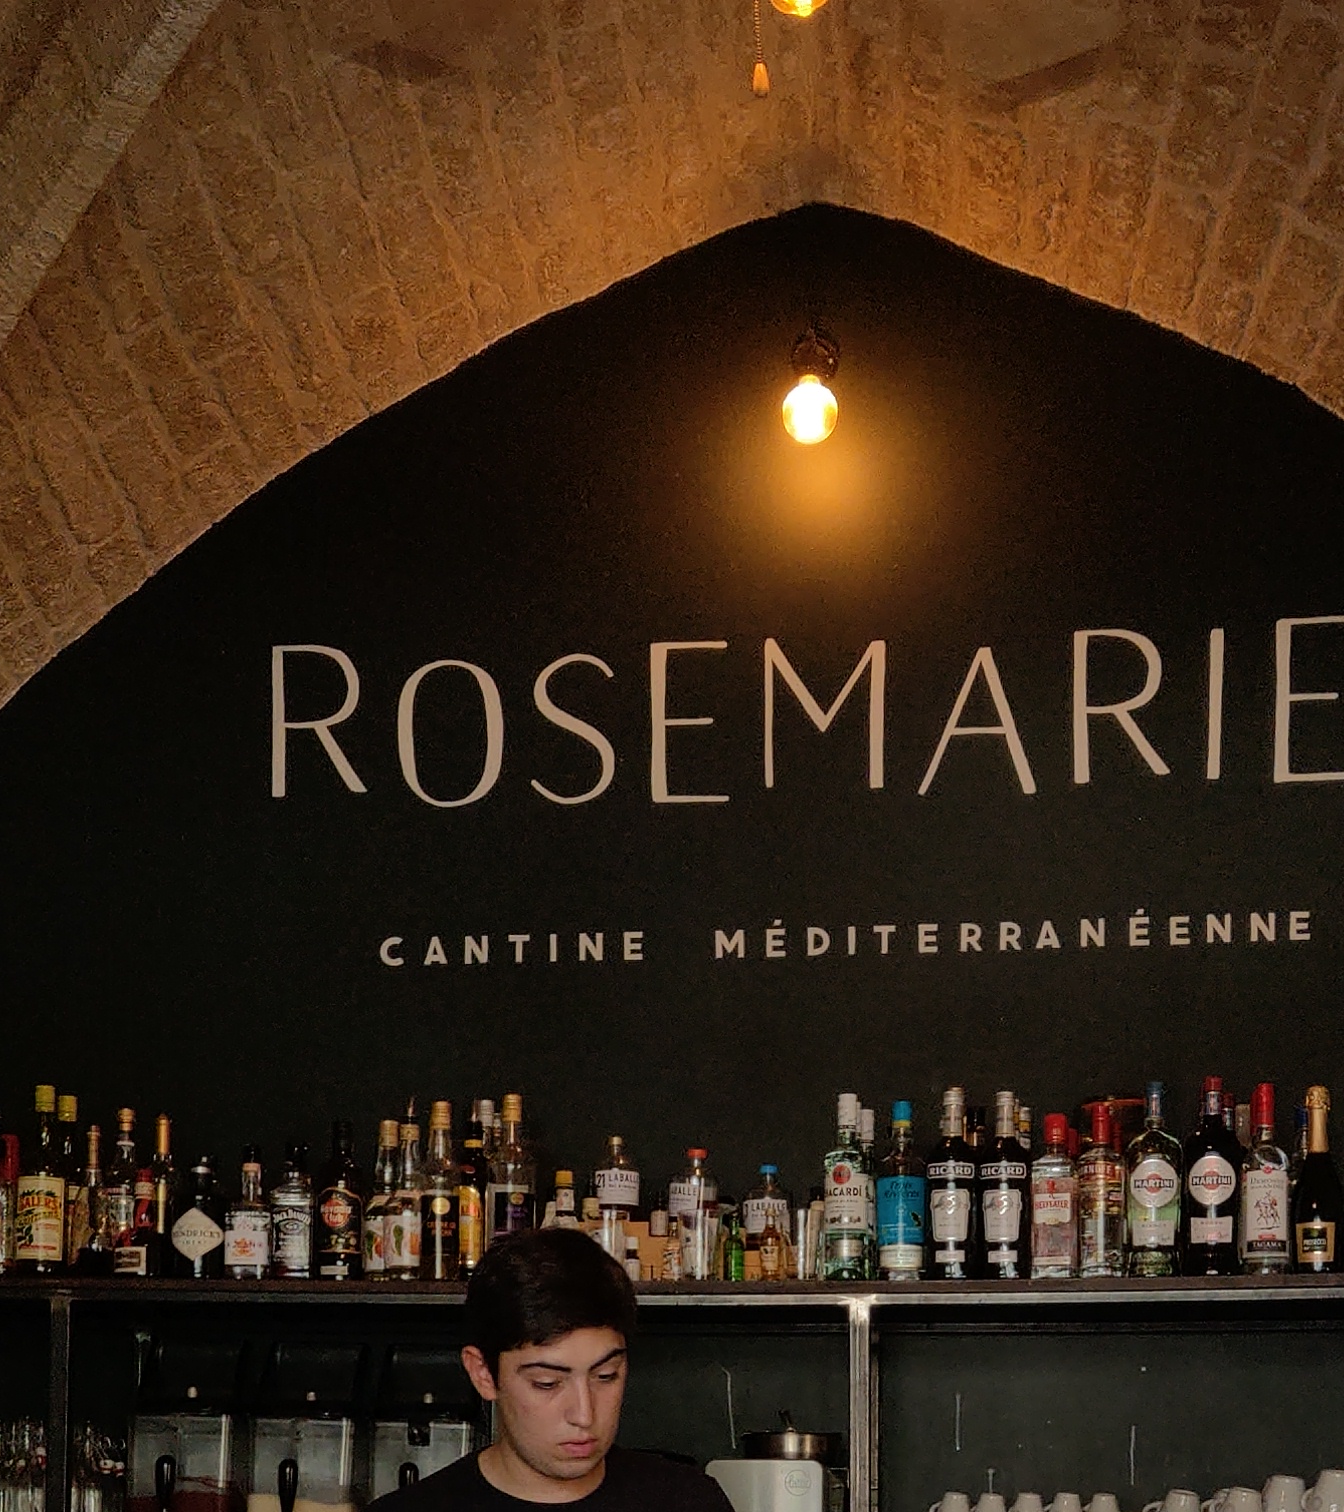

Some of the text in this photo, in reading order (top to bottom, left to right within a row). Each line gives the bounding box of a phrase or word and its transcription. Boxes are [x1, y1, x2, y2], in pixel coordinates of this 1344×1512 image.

[378, 908, 1316, 967] CANTINE MÉDITERRANÉENNE
[929, 1167, 971, 1175] RICARD
[981, 1167, 1023, 1175] RICARD
[1135, 1180, 1173, 1188] MARTINI
[1193, 1176, 1231, 1185] MARTINI
[826, 1185, 862, 1197] ACARDÍ
